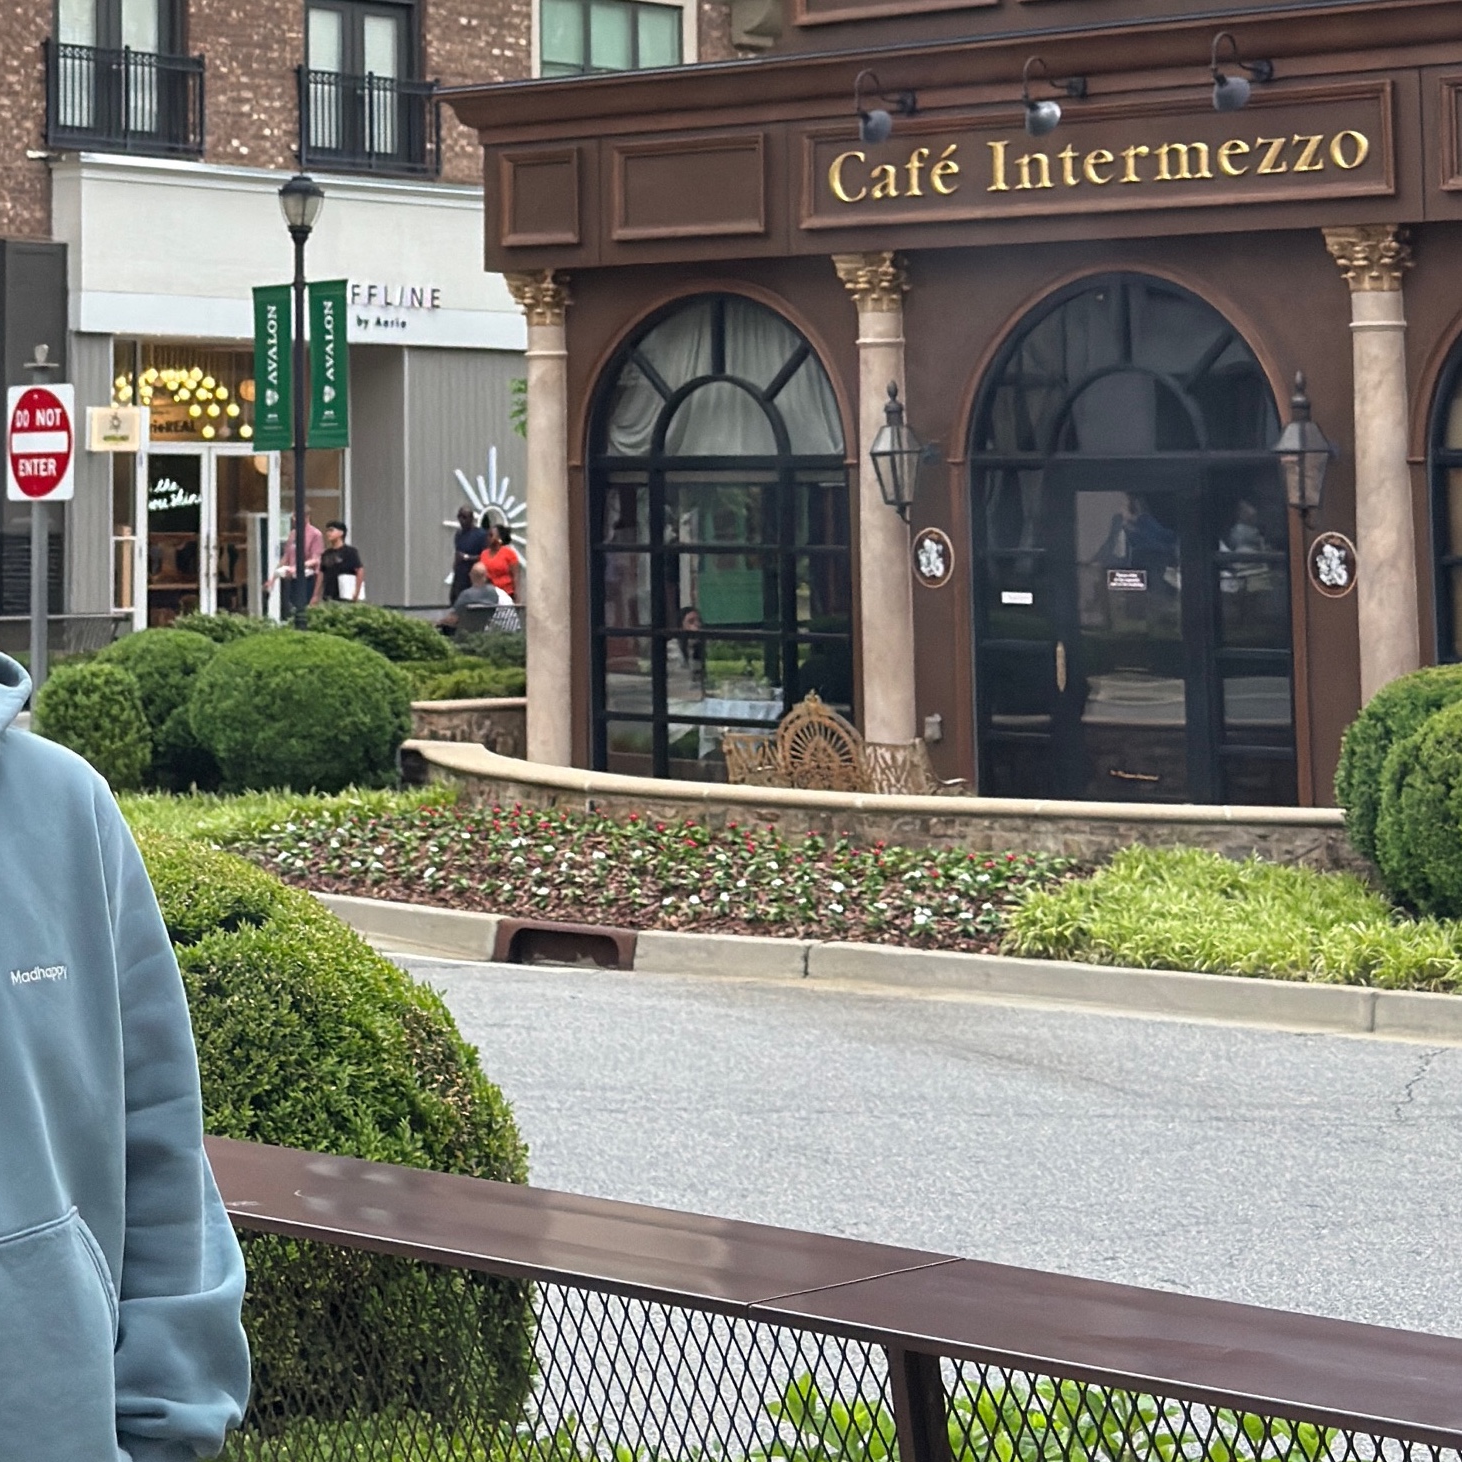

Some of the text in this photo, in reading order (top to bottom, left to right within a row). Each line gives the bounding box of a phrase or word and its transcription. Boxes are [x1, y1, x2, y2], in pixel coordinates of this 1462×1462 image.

[827, 129, 1370, 203] Café Intermezzo
[350, 284, 441, 309] FFLINE
[356, 315, 369, 330] by
[266, 304, 279, 386] AVALON
[323, 300, 336, 382] AVALON
[15, 407, 63, 428] DO NOT
[18, 457, 57, 477] ENTER
[10, 965, 68, 986] Madhappy
